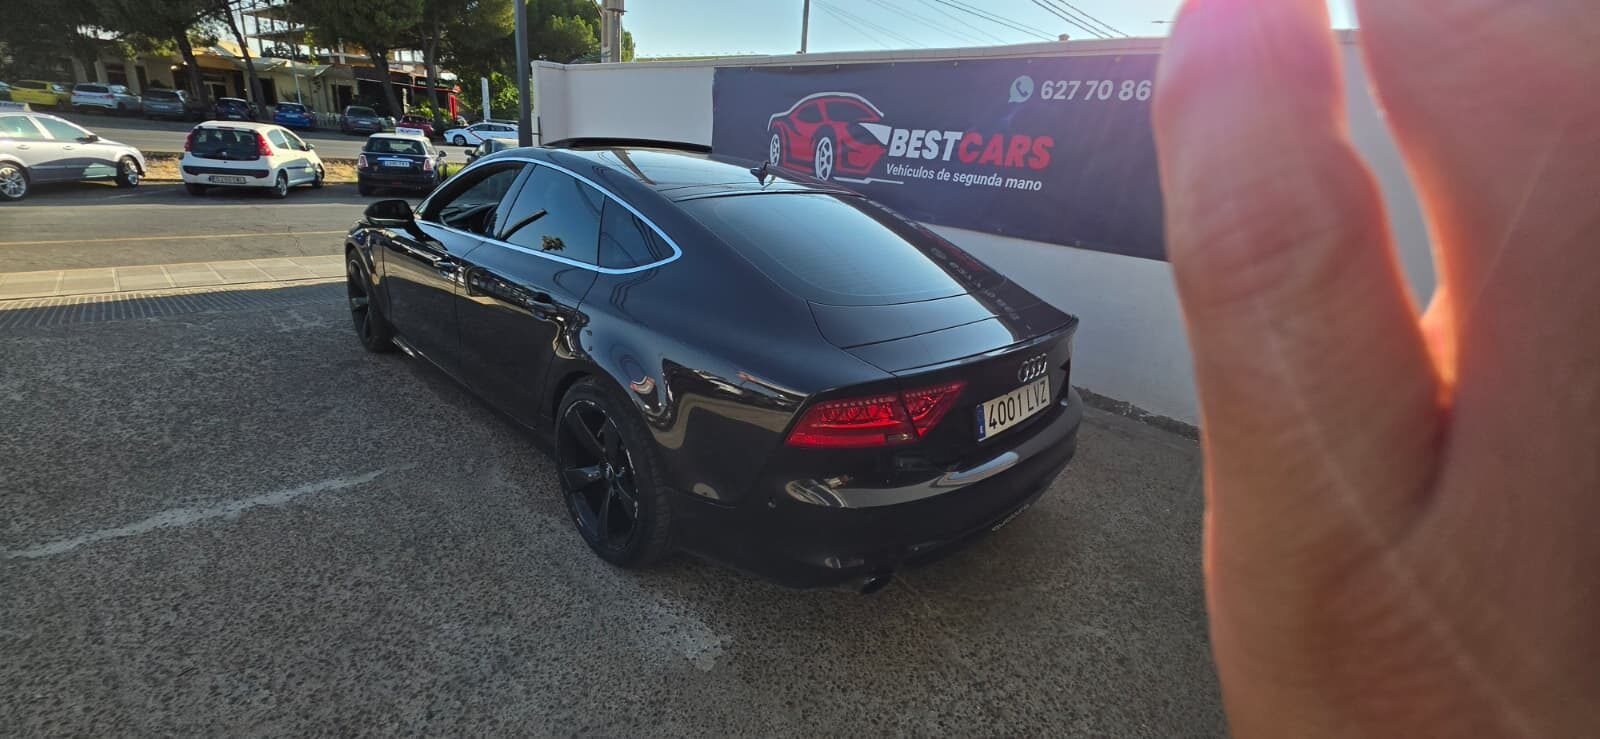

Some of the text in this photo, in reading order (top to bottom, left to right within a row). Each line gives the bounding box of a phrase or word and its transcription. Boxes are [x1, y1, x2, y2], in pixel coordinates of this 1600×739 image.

[1040, 80, 1152, 101] 627 70 86
[886, 163, 1042, 191] Vehículos de segunda mano
[988, 381, 1047, 430] 4001 LVZ
